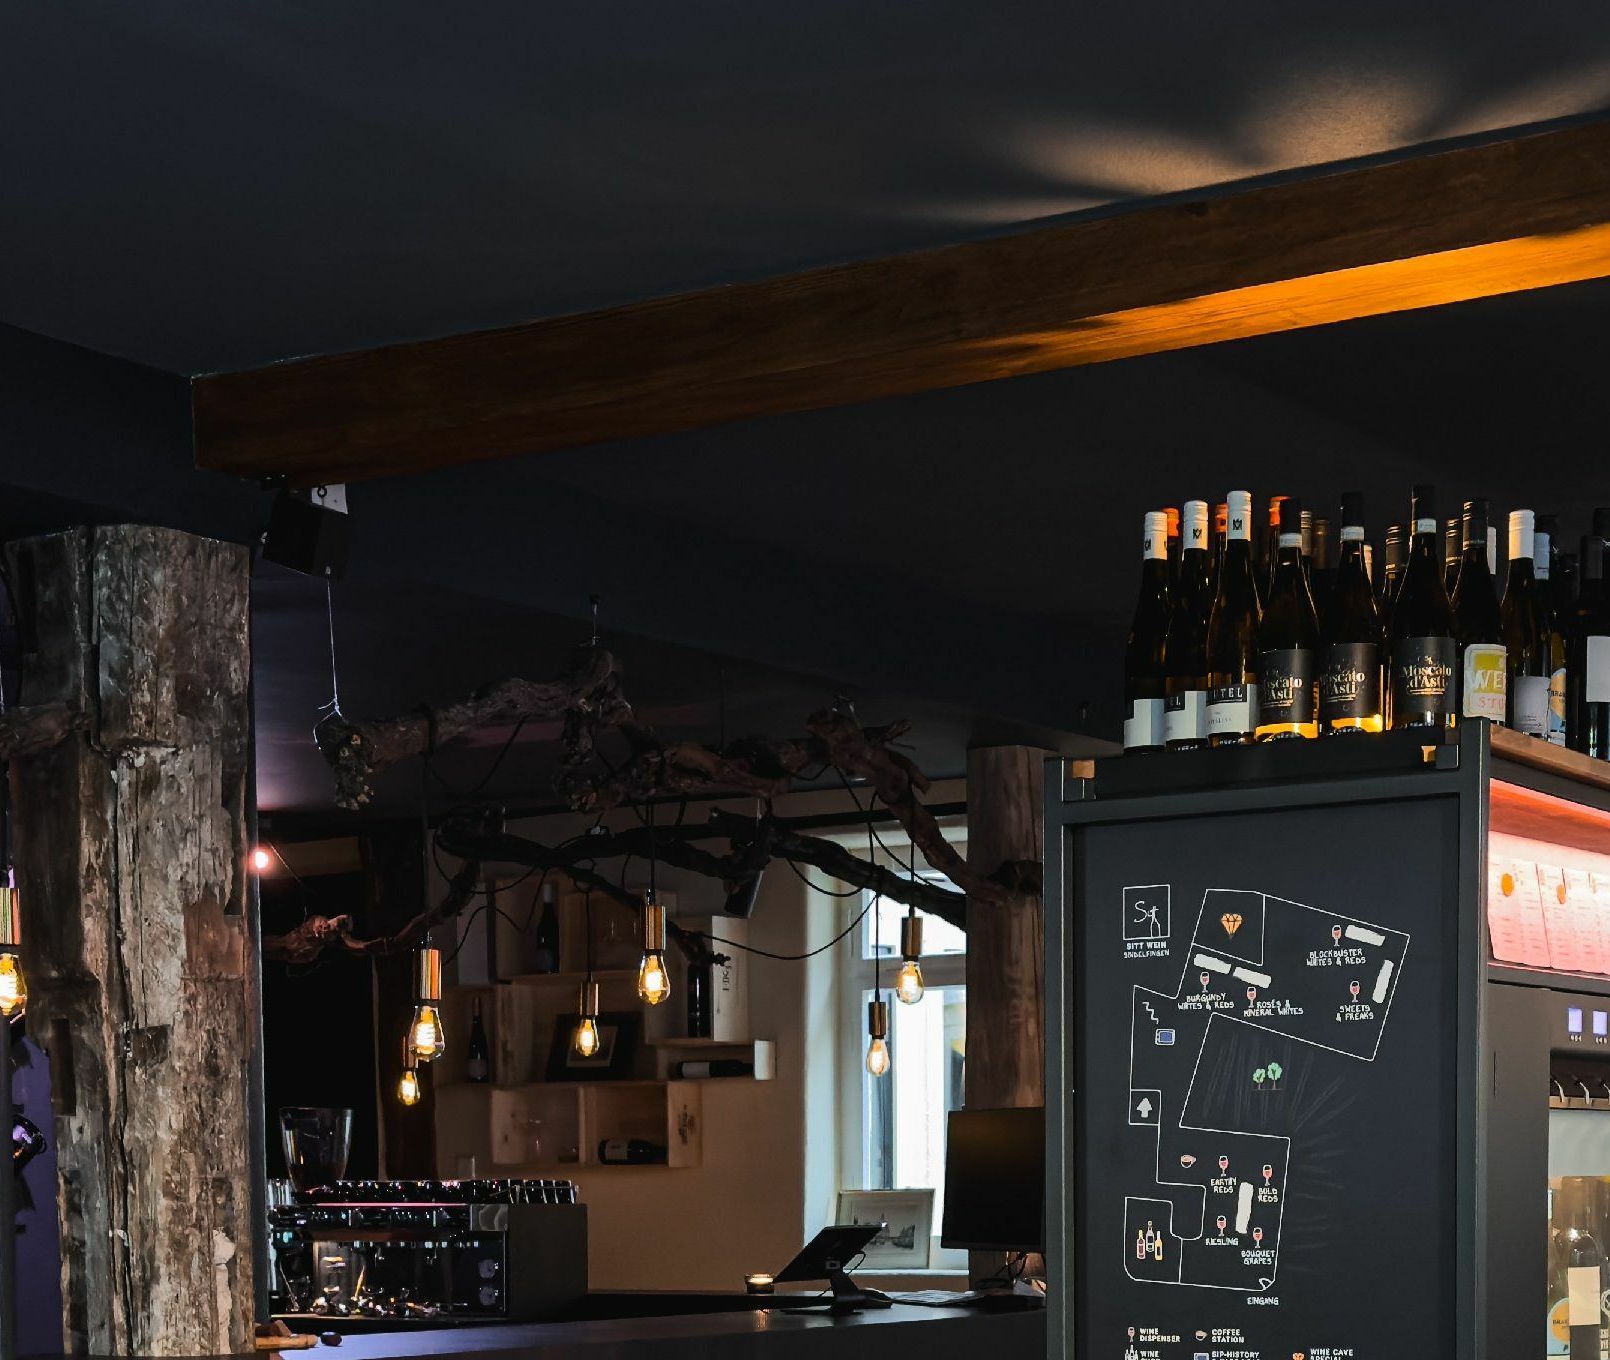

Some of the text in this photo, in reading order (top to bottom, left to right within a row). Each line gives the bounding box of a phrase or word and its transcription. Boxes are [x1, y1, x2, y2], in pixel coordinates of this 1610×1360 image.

[1309, 948, 1363, 959] BLOCKBUSTER
[1344, 956, 1367, 965] REDS
[1186, 992, 1227, 1002] BURGUNDY
[1339, 1004, 1371, 1013] SWEETS
[1213, 1185, 1234, 1194] REDS
[1258, 1195, 1279, 1203] REDS
[1205, 1237, 1239, 1246] RIESLING
[1241, 1249, 1276, 1258] BOUQUET
[1243, 1256, 1272, 1265] GRAPES
[1139, 1327, 1159, 1335] WINE
[1211, 1328, 1241, 1336] COFFEE
[1211, 1335, 1245, 1343] STATION
[1140, 1350, 1160, 1358] WINE
[1309, 1348, 1354, 1357] WINE CAVE
